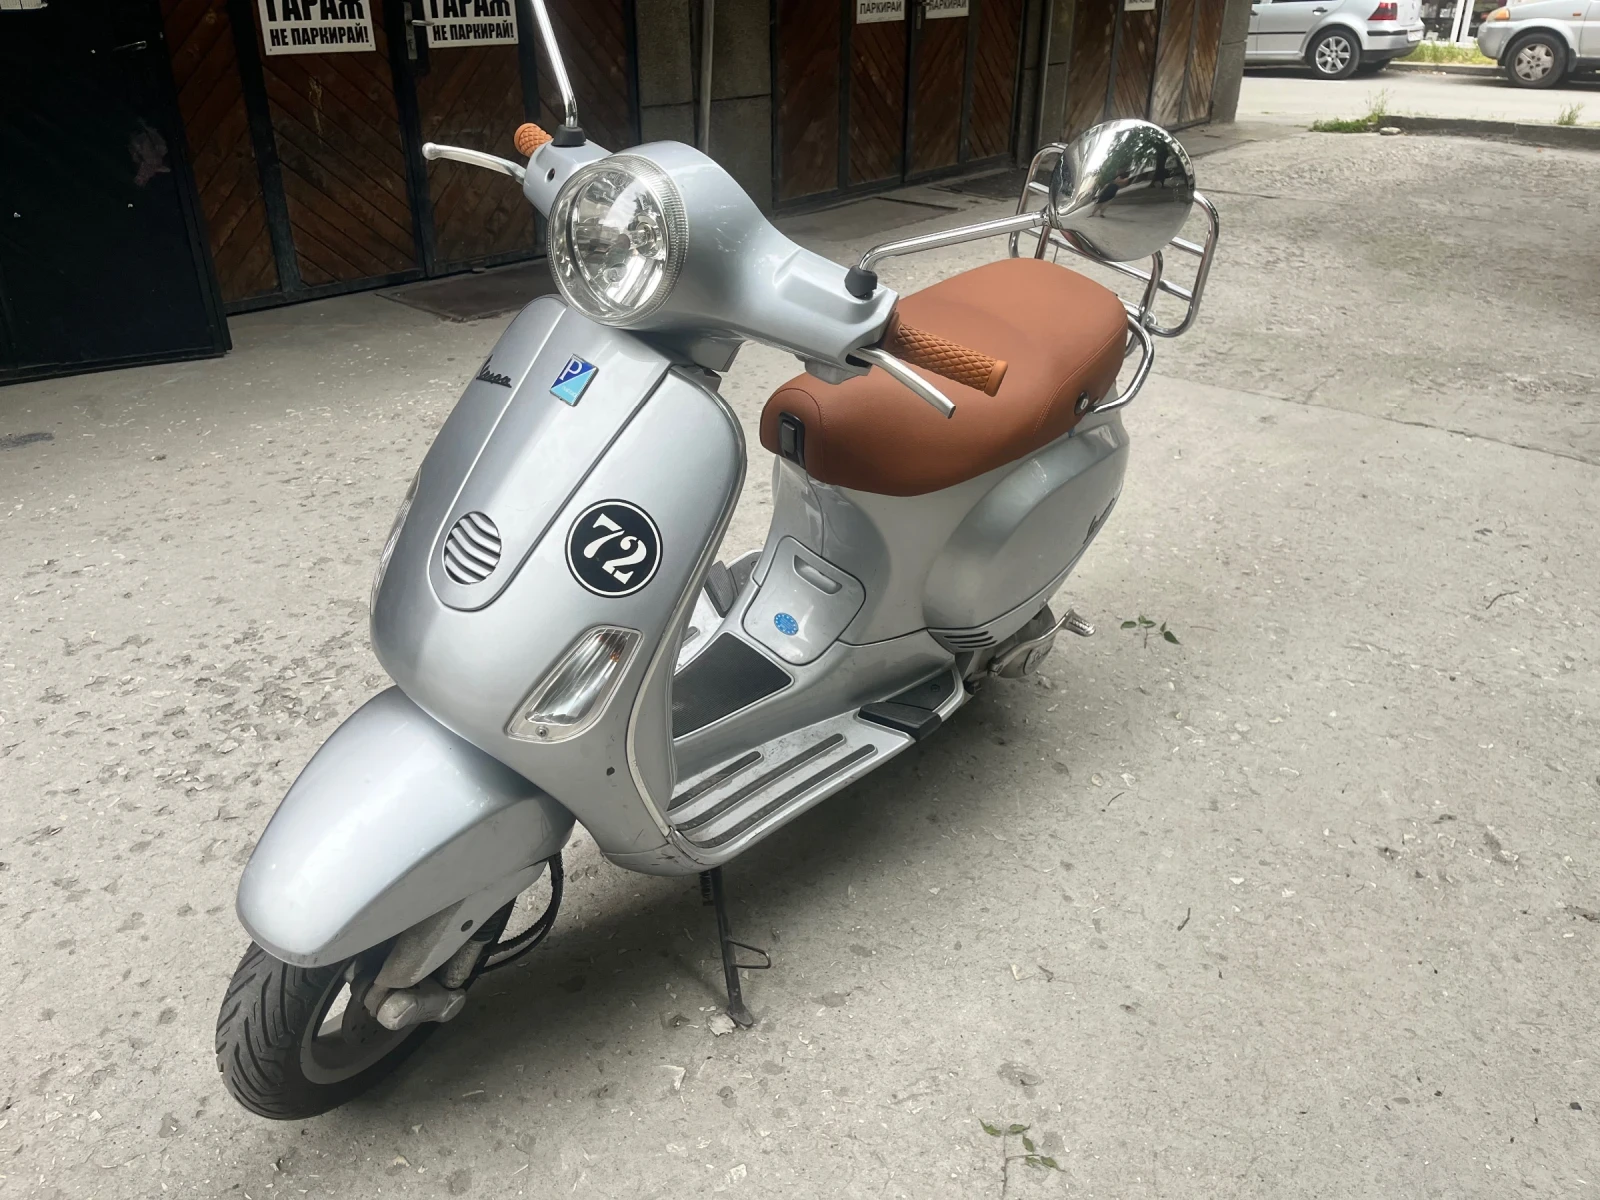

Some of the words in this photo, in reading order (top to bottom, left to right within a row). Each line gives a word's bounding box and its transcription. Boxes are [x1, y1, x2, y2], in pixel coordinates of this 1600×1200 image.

[269, 28, 289, 46] НЕ
[290, 22, 370, 45] ПАРКИРАЙ!
[432, 24, 448, 41] НЕ
[449, 20, 514, 40] ПАРКИРАЙ!
[583, 513, 647, 585] 72
